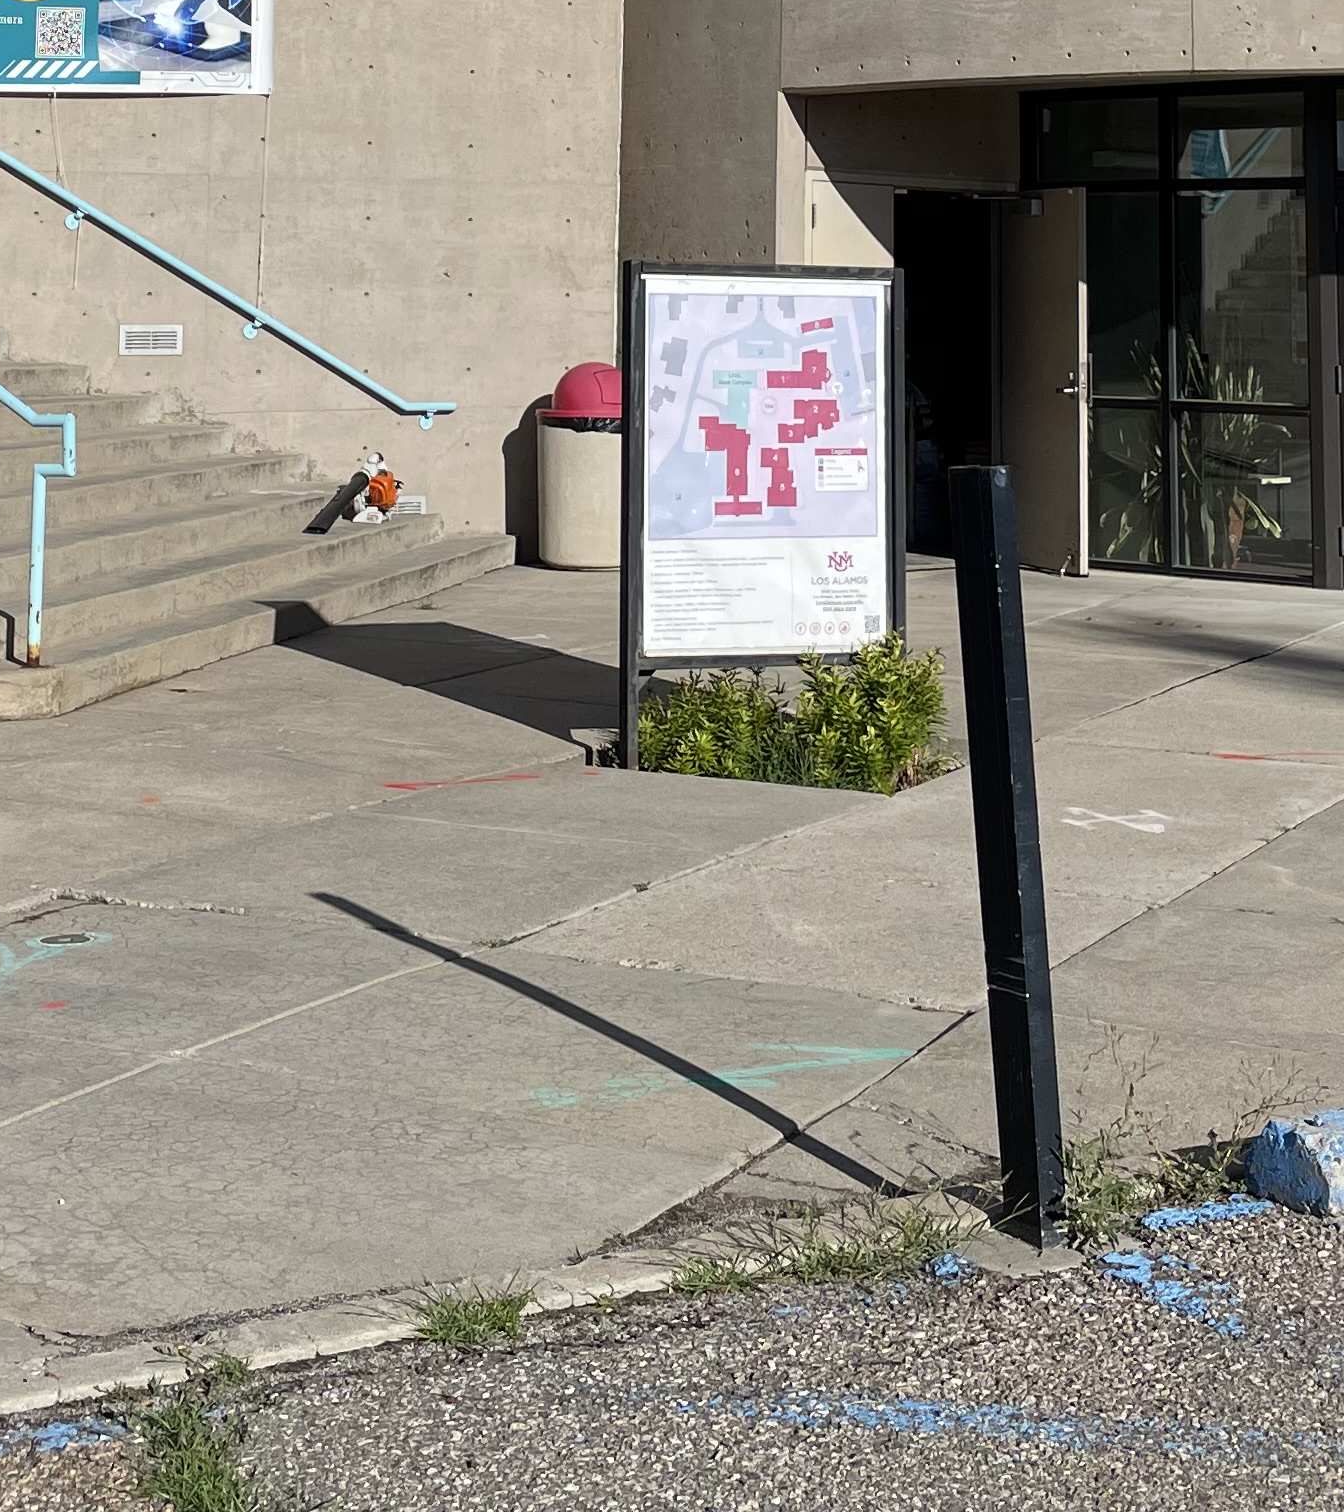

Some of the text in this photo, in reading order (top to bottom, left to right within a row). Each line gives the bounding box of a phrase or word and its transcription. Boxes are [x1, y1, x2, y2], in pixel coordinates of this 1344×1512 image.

[811, 366, 817, 374] 7
[781, 375, 786, 383] 1
[813, 405, 819, 414] 2
[788, 429, 794, 437] 3
[772, 454, 778, 462] 4
[779, 483, 785, 491] 5
[810, 576, 868, 585] LOS ALAMOS
